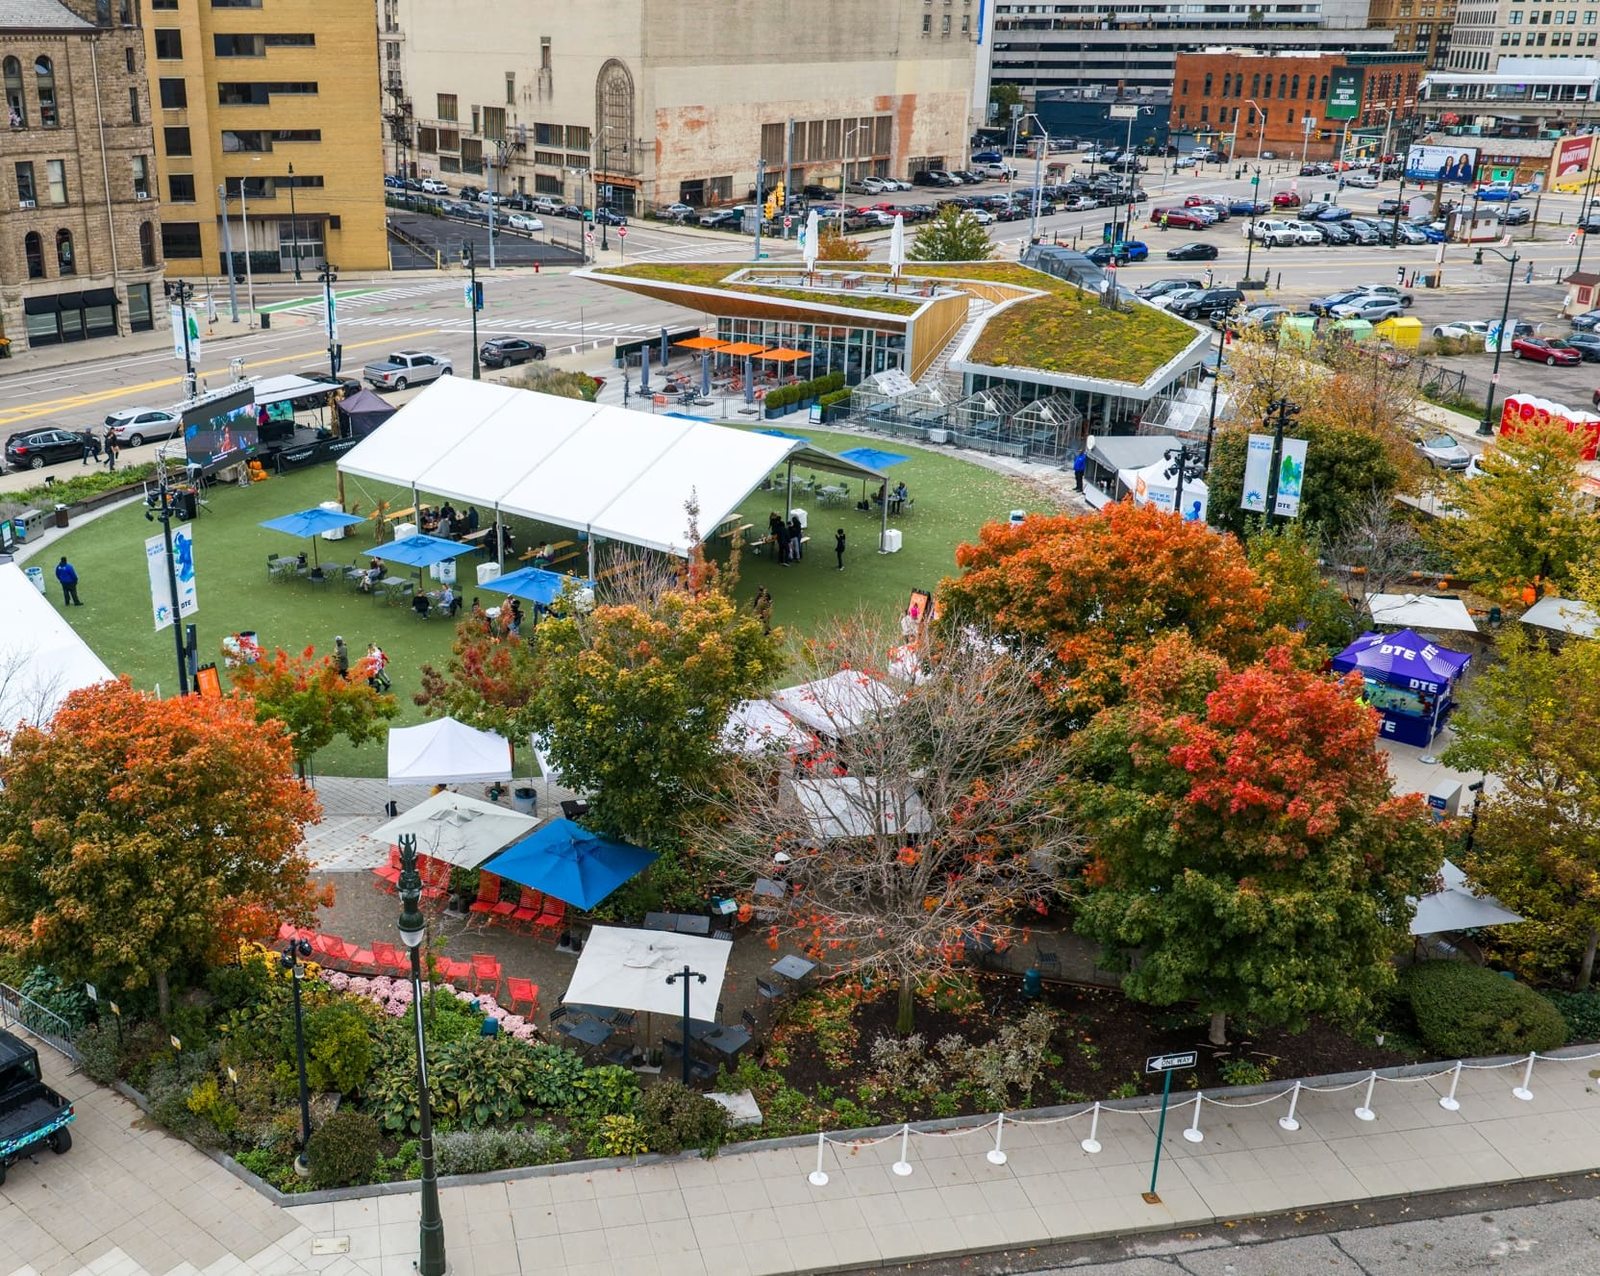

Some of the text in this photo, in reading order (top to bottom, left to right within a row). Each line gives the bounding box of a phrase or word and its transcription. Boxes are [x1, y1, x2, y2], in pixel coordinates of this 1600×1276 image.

[181, 599, 192, 609] DTE
[1380, 644, 1416, 661] DTE
[1420, 643, 1439, 661] DTE
[1409, 678, 1438, 693] DTE
[1377, 719, 1396, 733] TE
[1176, 1056, 1191, 1064] WAY
